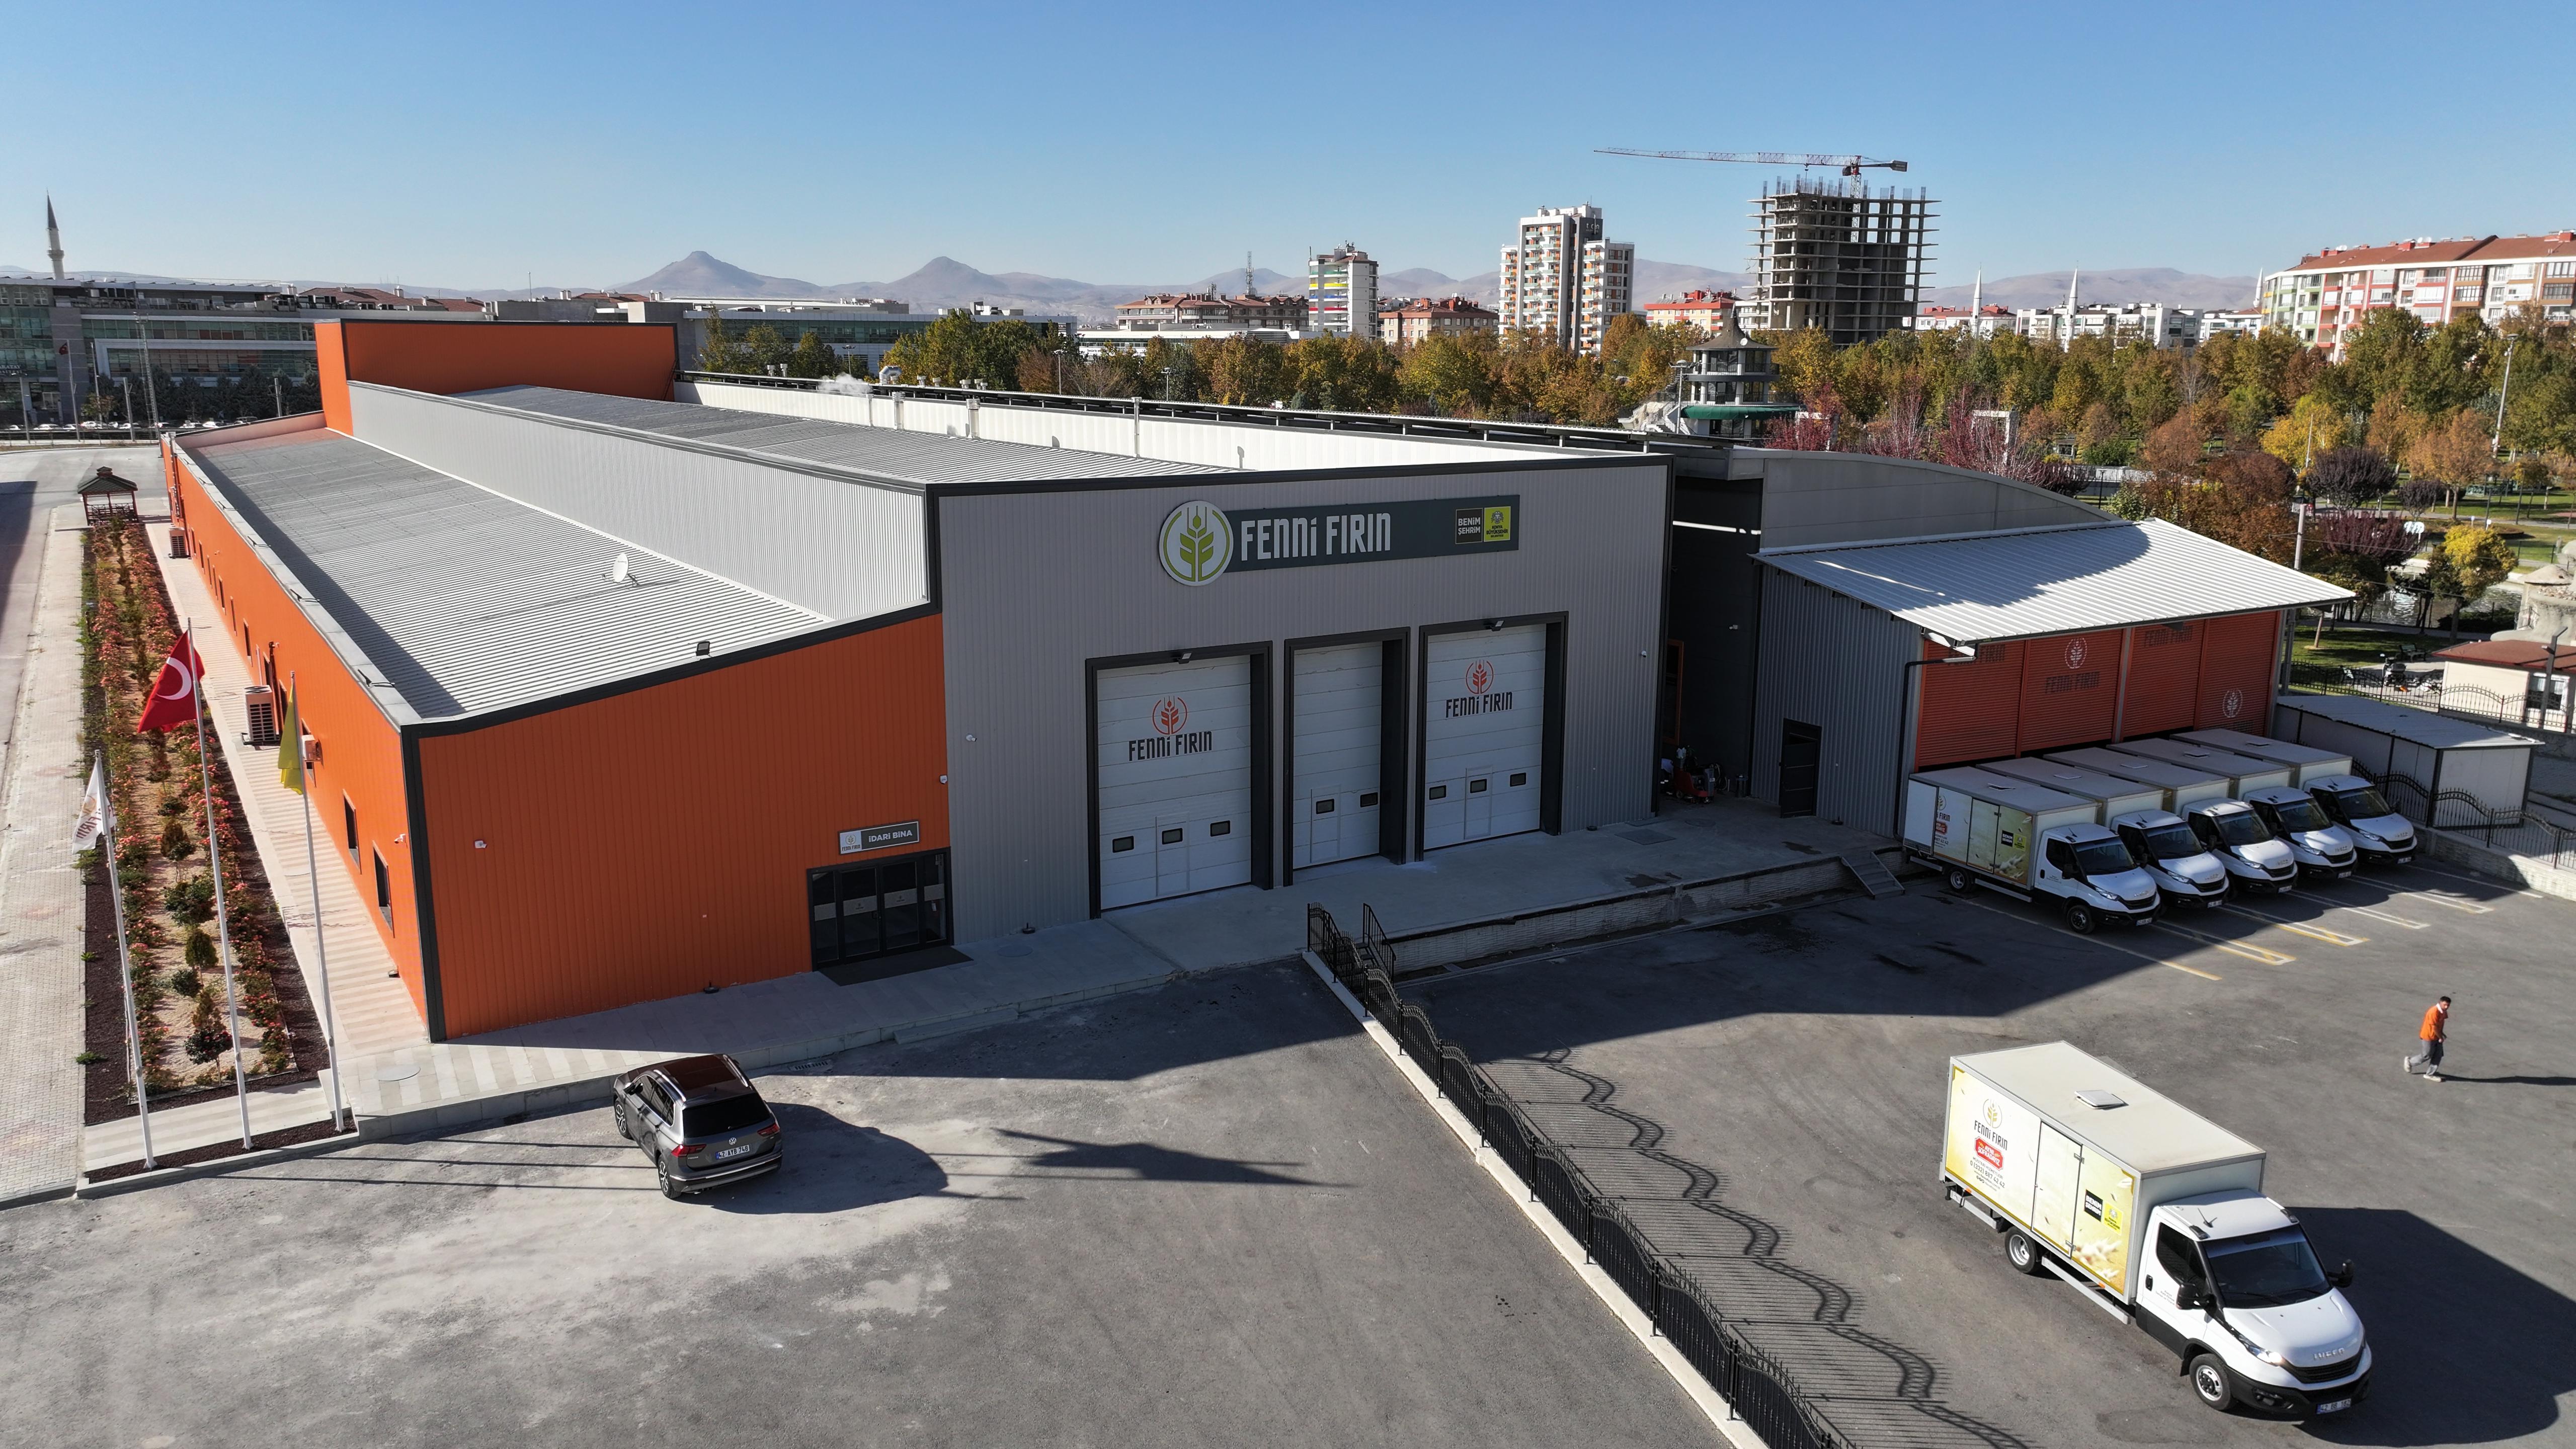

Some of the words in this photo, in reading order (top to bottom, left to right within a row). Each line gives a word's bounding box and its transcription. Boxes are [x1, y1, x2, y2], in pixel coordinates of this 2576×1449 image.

[1326, 513, 1391, 555] FIRIN
[1483, 692, 1513, 713] FIRIN
[1175, 731, 1212, 755] FIRIN
[1992, 1132, 2007, 1151] FIRIN
[2314, 1348, 2345, 1360] IVECO
